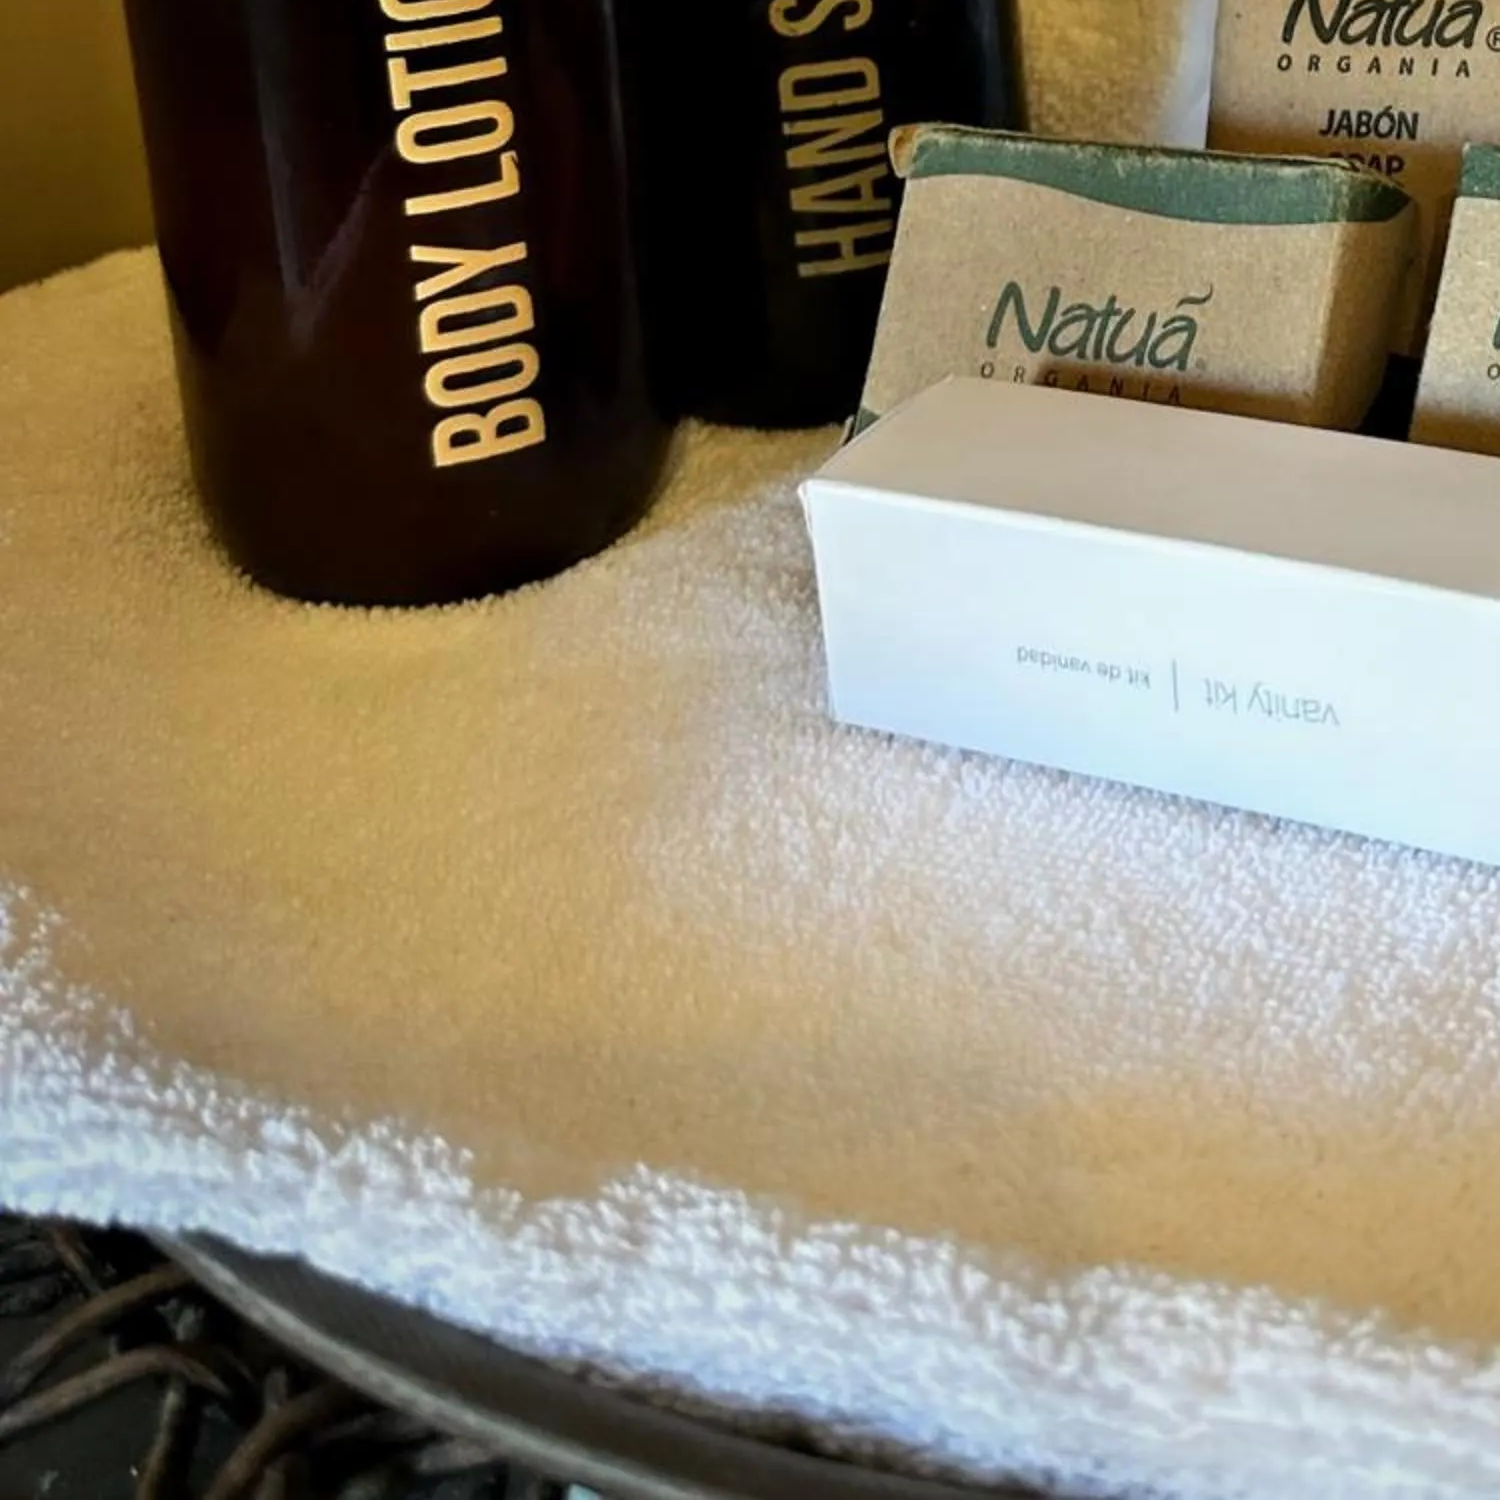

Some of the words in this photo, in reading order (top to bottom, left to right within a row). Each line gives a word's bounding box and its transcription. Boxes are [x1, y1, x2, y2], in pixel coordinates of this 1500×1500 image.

[1277, 53, 1470, 79] ORGANIA
[1318, 105, 1419, 140] JABÓN
[778, 56, 894, 277] HAND
[1329, 152, 1406, 177] AP
[410, 242, 546, 468] BODY
[980, 362, 1182, 404] ORGANIA
[1016, 645, 1092, 676] vanidad
[1096, 660, 1122, 680] de
[1128, 664, 1151, 689] kit
[1203, 677, 1238, 714] kit
[1247, 681, 1341, 727] vanity
